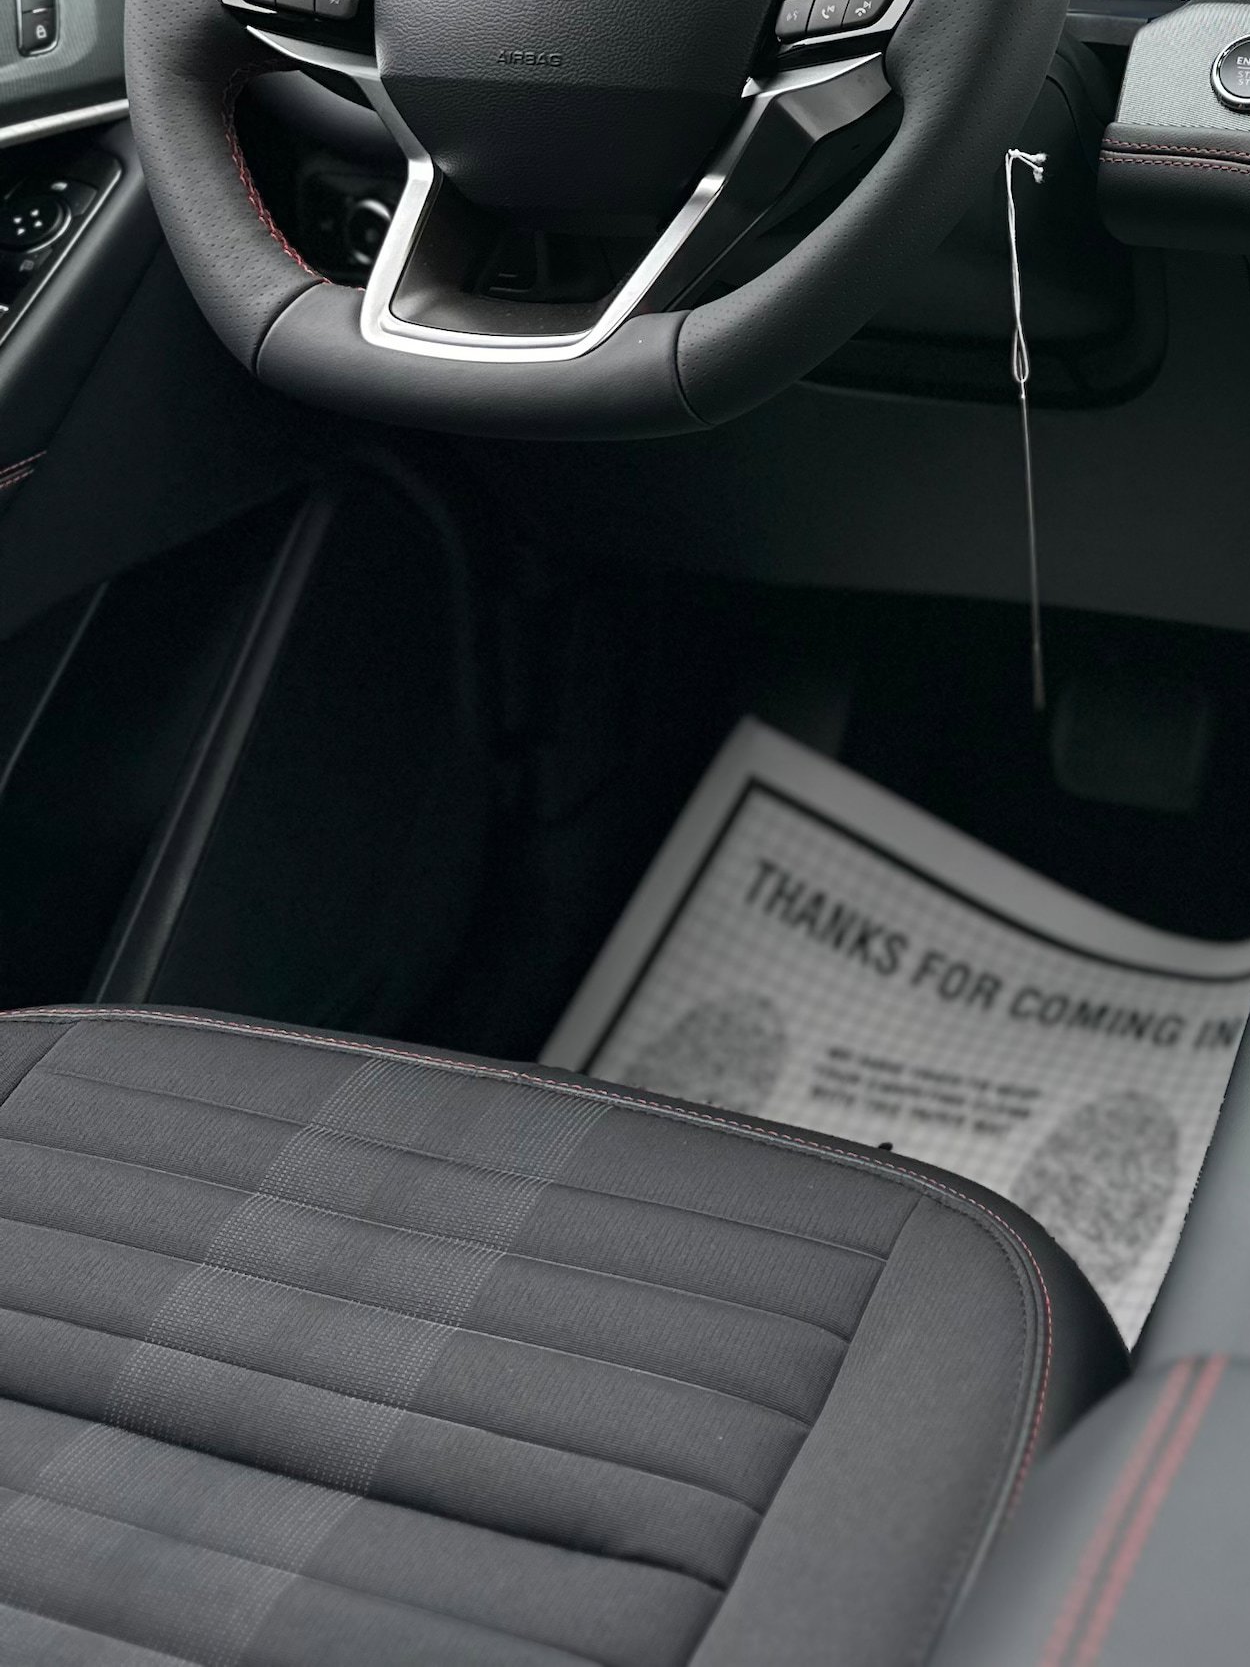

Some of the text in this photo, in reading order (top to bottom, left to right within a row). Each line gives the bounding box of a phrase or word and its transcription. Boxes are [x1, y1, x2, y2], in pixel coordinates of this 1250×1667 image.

[497, 50, 562, 67] AIRBAG
[744, 860, 1244, 1051] THANKS FOR COMING IN
